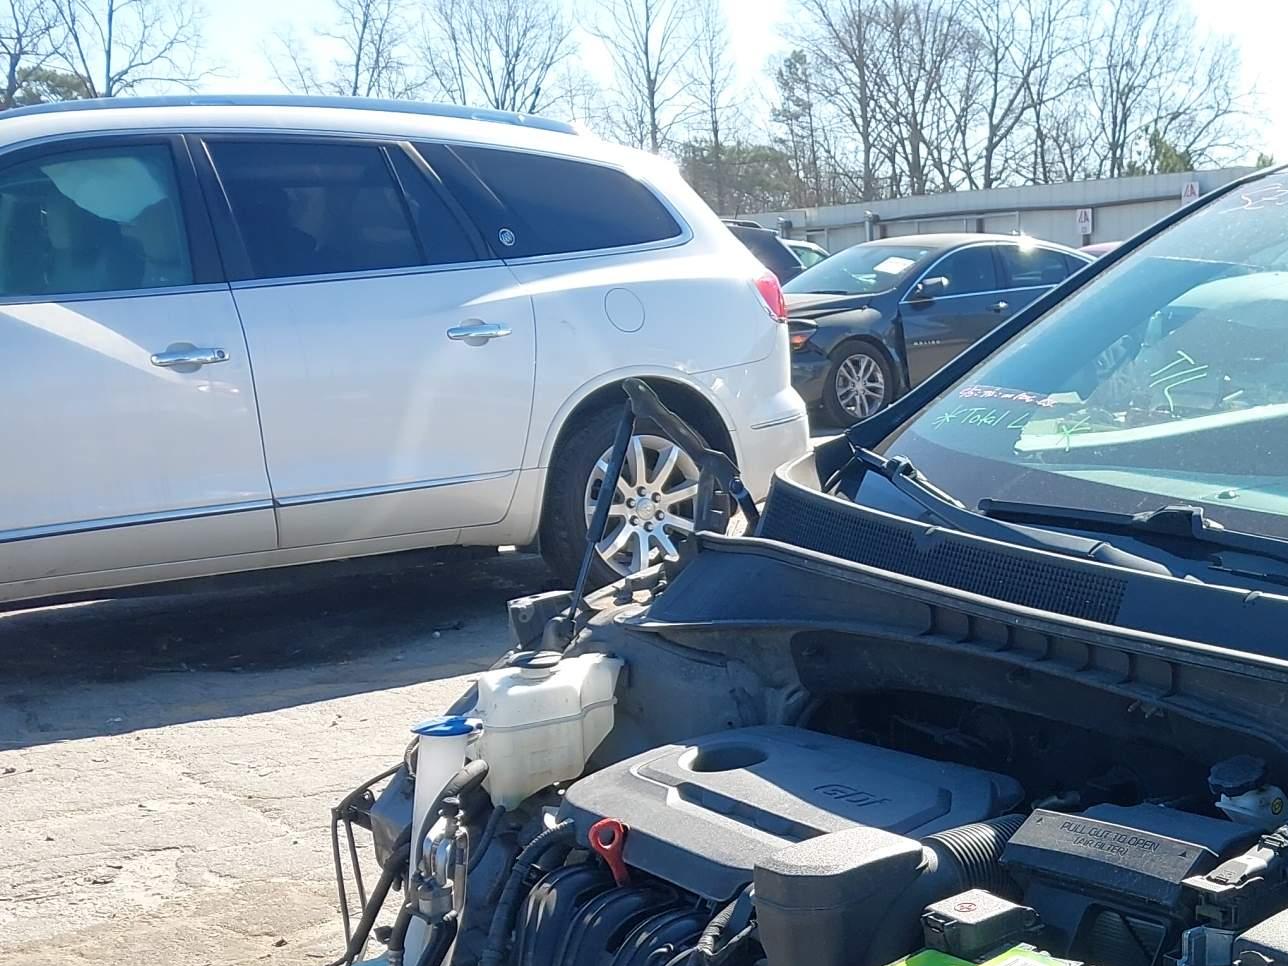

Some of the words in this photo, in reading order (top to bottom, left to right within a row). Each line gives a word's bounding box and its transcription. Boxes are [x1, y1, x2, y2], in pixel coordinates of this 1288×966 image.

[1060, 821, 1086, 836] PULL
[1088, 827, 1111, 840] OUT
[1112, 833, 1127, 844] TO
[1127, 836, 1160, 851] OPEN
[1073, 836, 1095, 849] (AIR
